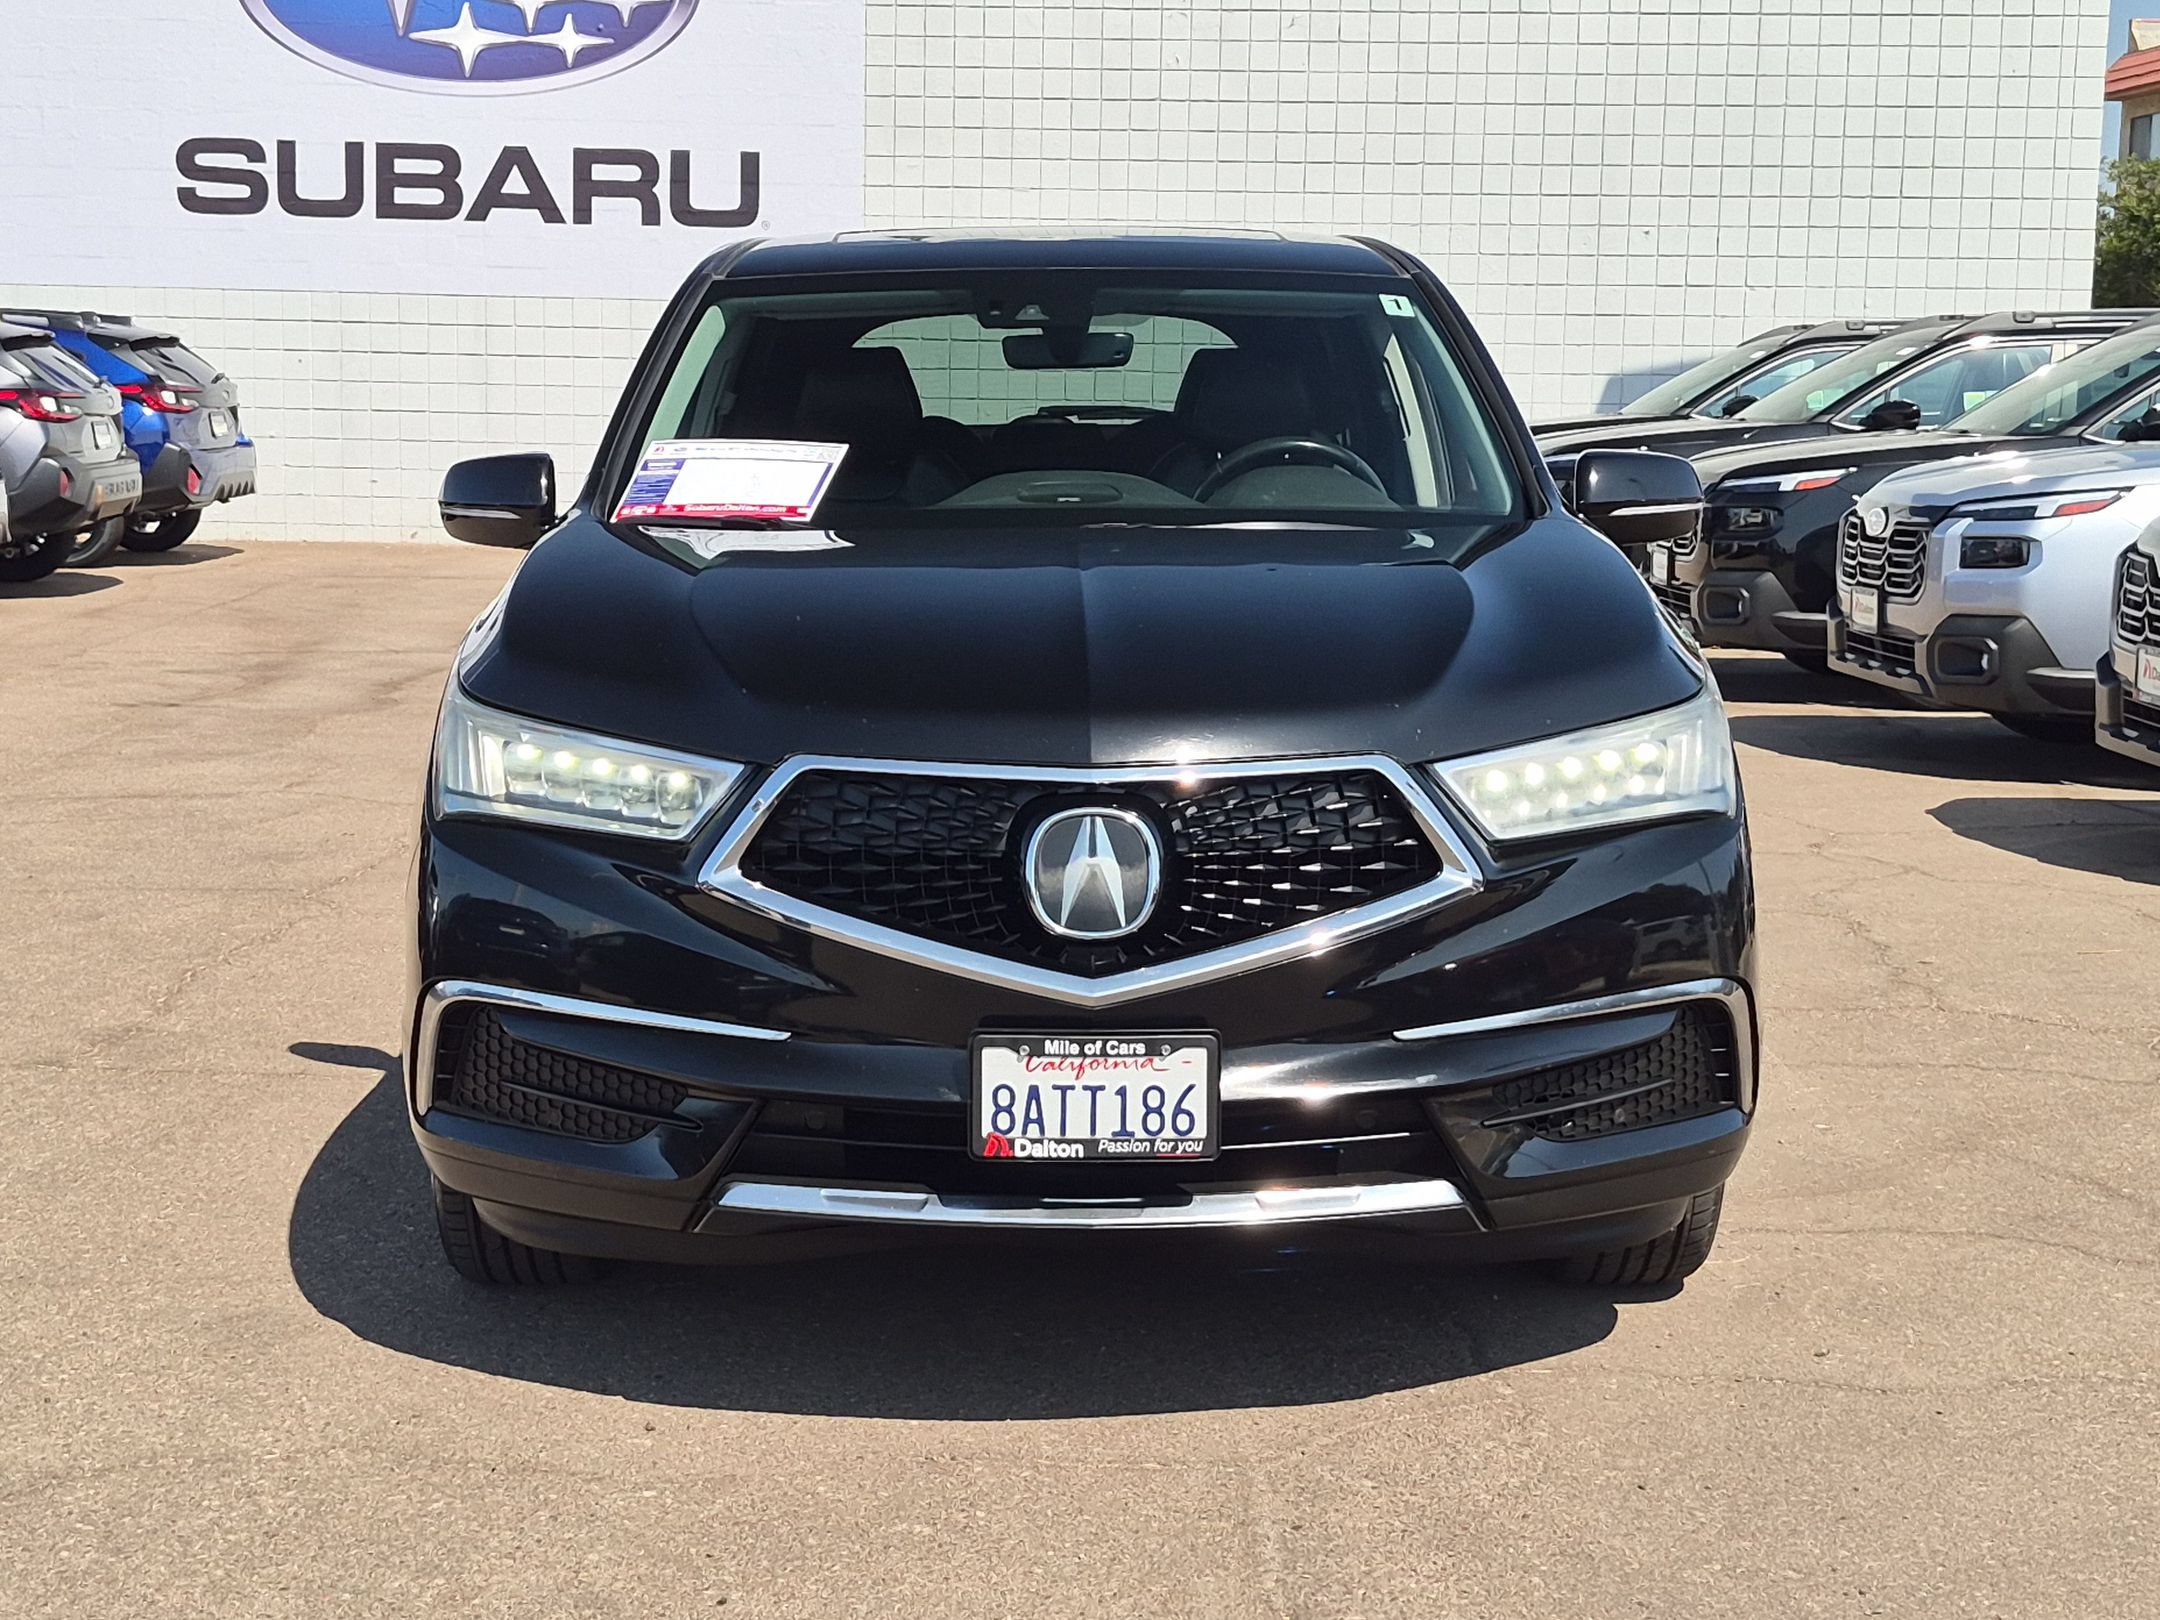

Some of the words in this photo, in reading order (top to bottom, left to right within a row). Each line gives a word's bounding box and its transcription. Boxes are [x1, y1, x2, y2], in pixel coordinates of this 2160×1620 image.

[175, 136, 761, 228] SUBARU
[1044, 1040, 1080, 1056] Mile
[1084, 1040, 1103, 1056] of
[1105, 1040, 1146, 1056] Cars
[1025, 1055, 1170, 1081] California
[991, 1083, 1197, 1137] 8ATT186
[1014, 1138, 1085, 1158] Dalton
[1097, 1139, 1151, 1153] Passion
[1153, 1138, 1175, 1153] for
[1175, 1140, 1204, 1154] you
